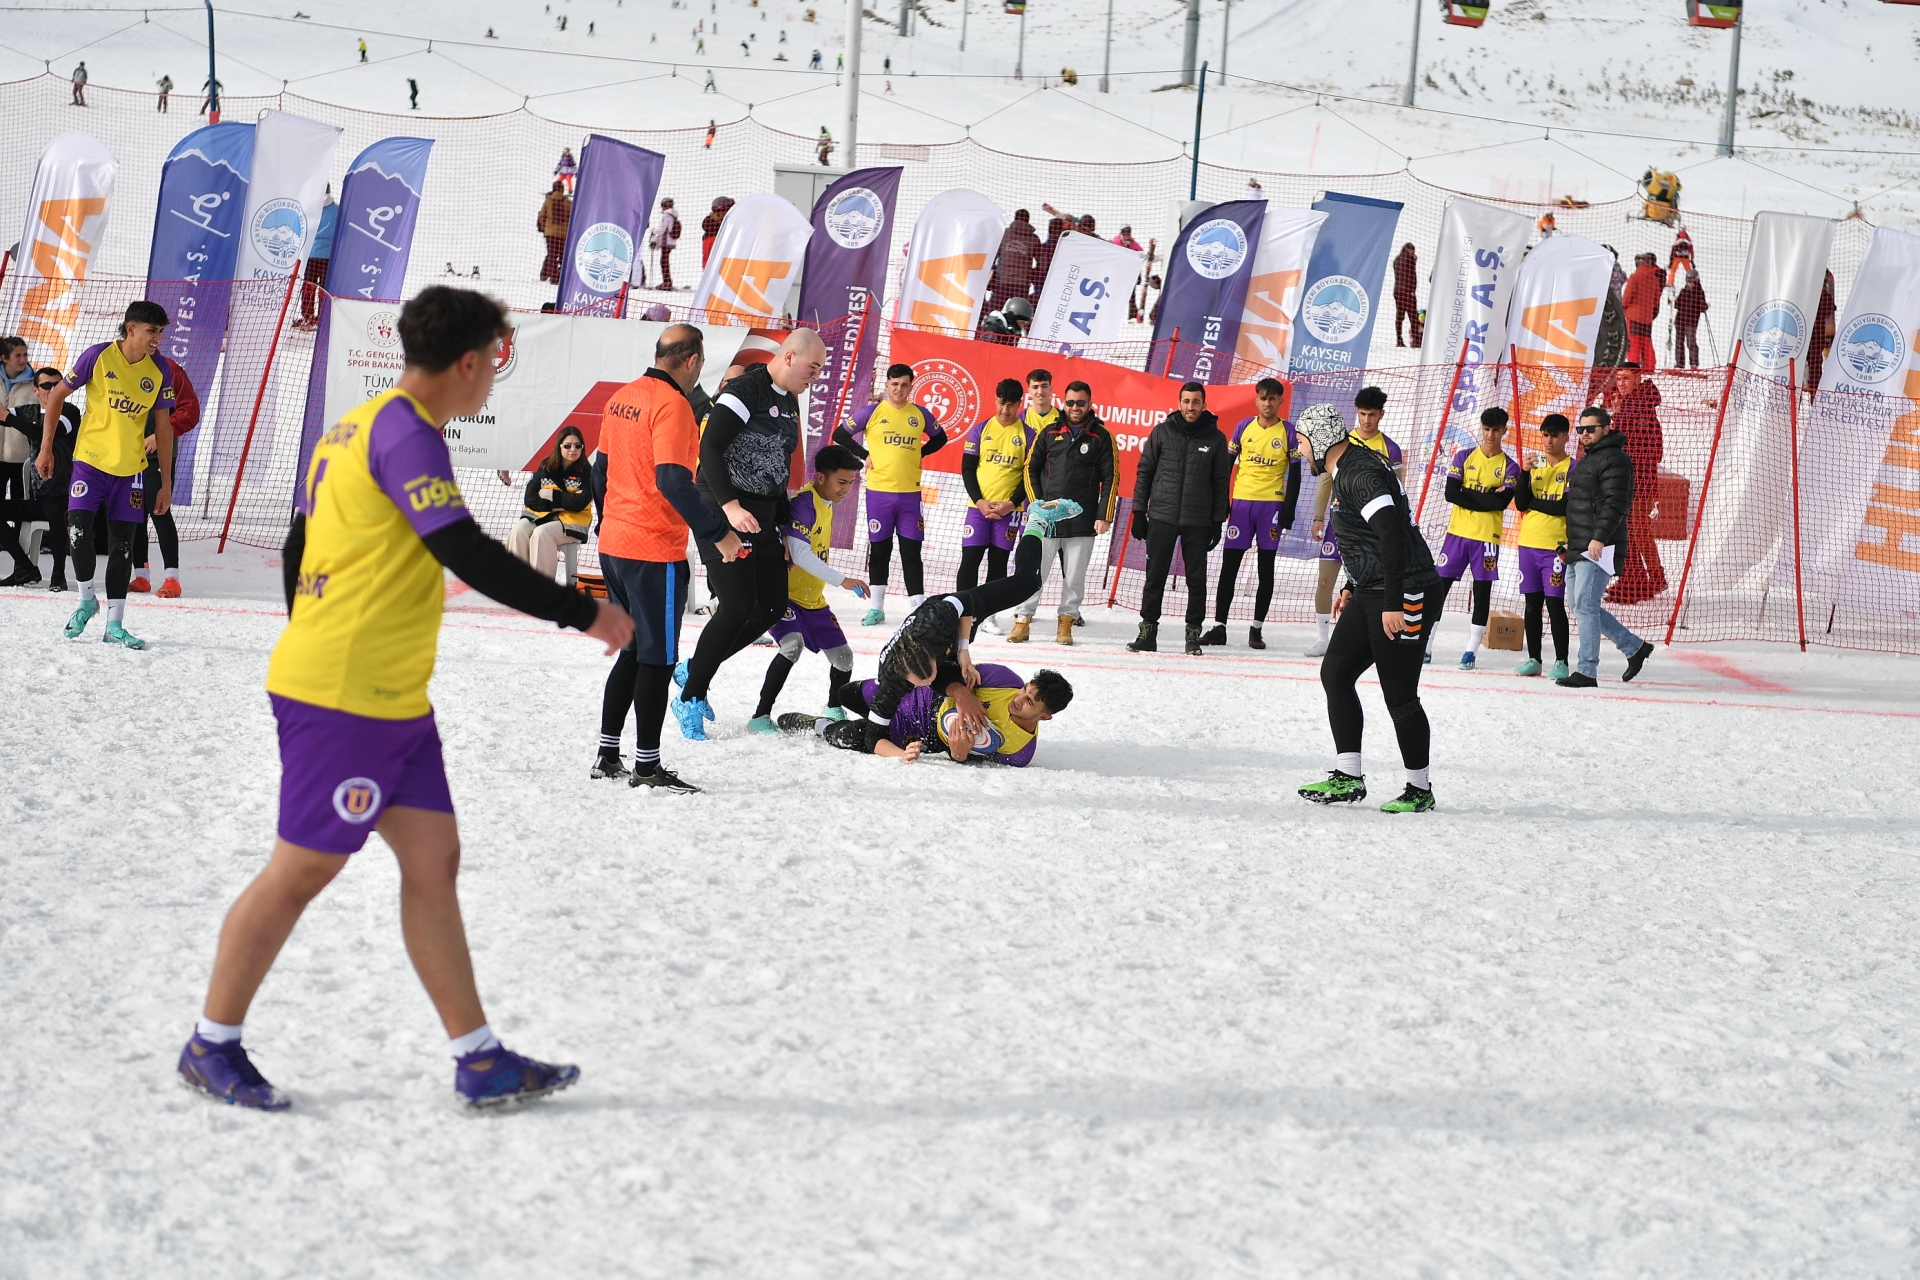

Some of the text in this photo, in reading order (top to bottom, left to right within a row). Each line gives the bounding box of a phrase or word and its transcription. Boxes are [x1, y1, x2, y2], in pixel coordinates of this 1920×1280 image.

[358, 257, 382, 299] A.Ş.
[592, 281, 608, 290] 1869
[1471, 245, 1504, 309] A.Ş.
[573, 291, 618, 311] KAYSER
[1054, 264, 1081, 321] BELEDİYESİ
[1306, 290, 1317, 320] KAYSERİ
[1316, 278, 1358, 291] BÜYÜKŞEHİR
[1444, 298, 1465, 364] BÜYÜKŞEHİR
[1455, 235, 1474, 297] BELEDİYESİ
[170, 244, 209, 371] CİYES A.Ş.
[1068, 276, 1110, 336] A.Ş.
[1192, 315, 1224, 386] EDİYESİ
[1842, 316, 1902, 370] KAYSERİ BÜYÜKŞEHİR BELEDİYESİ
[347, 359, 370, 368] SPOR
[348, 349, 364, 358] T.C.
[1301, 344, 1352, 364] KAYSERİ
[363, 373, 395, 389] TÜM
[1835, 382, 1886, 403] KAYSERİ
[108, 396, 148, 415] uğur
[608, 401, 642, 423] HAKEM
[458, 444, 488, 455] Başkanı
[884, 433, 917, 446] uğur
[986, 452, 1019, 465] uğur
[1553, 557, 1563, 573] 8
